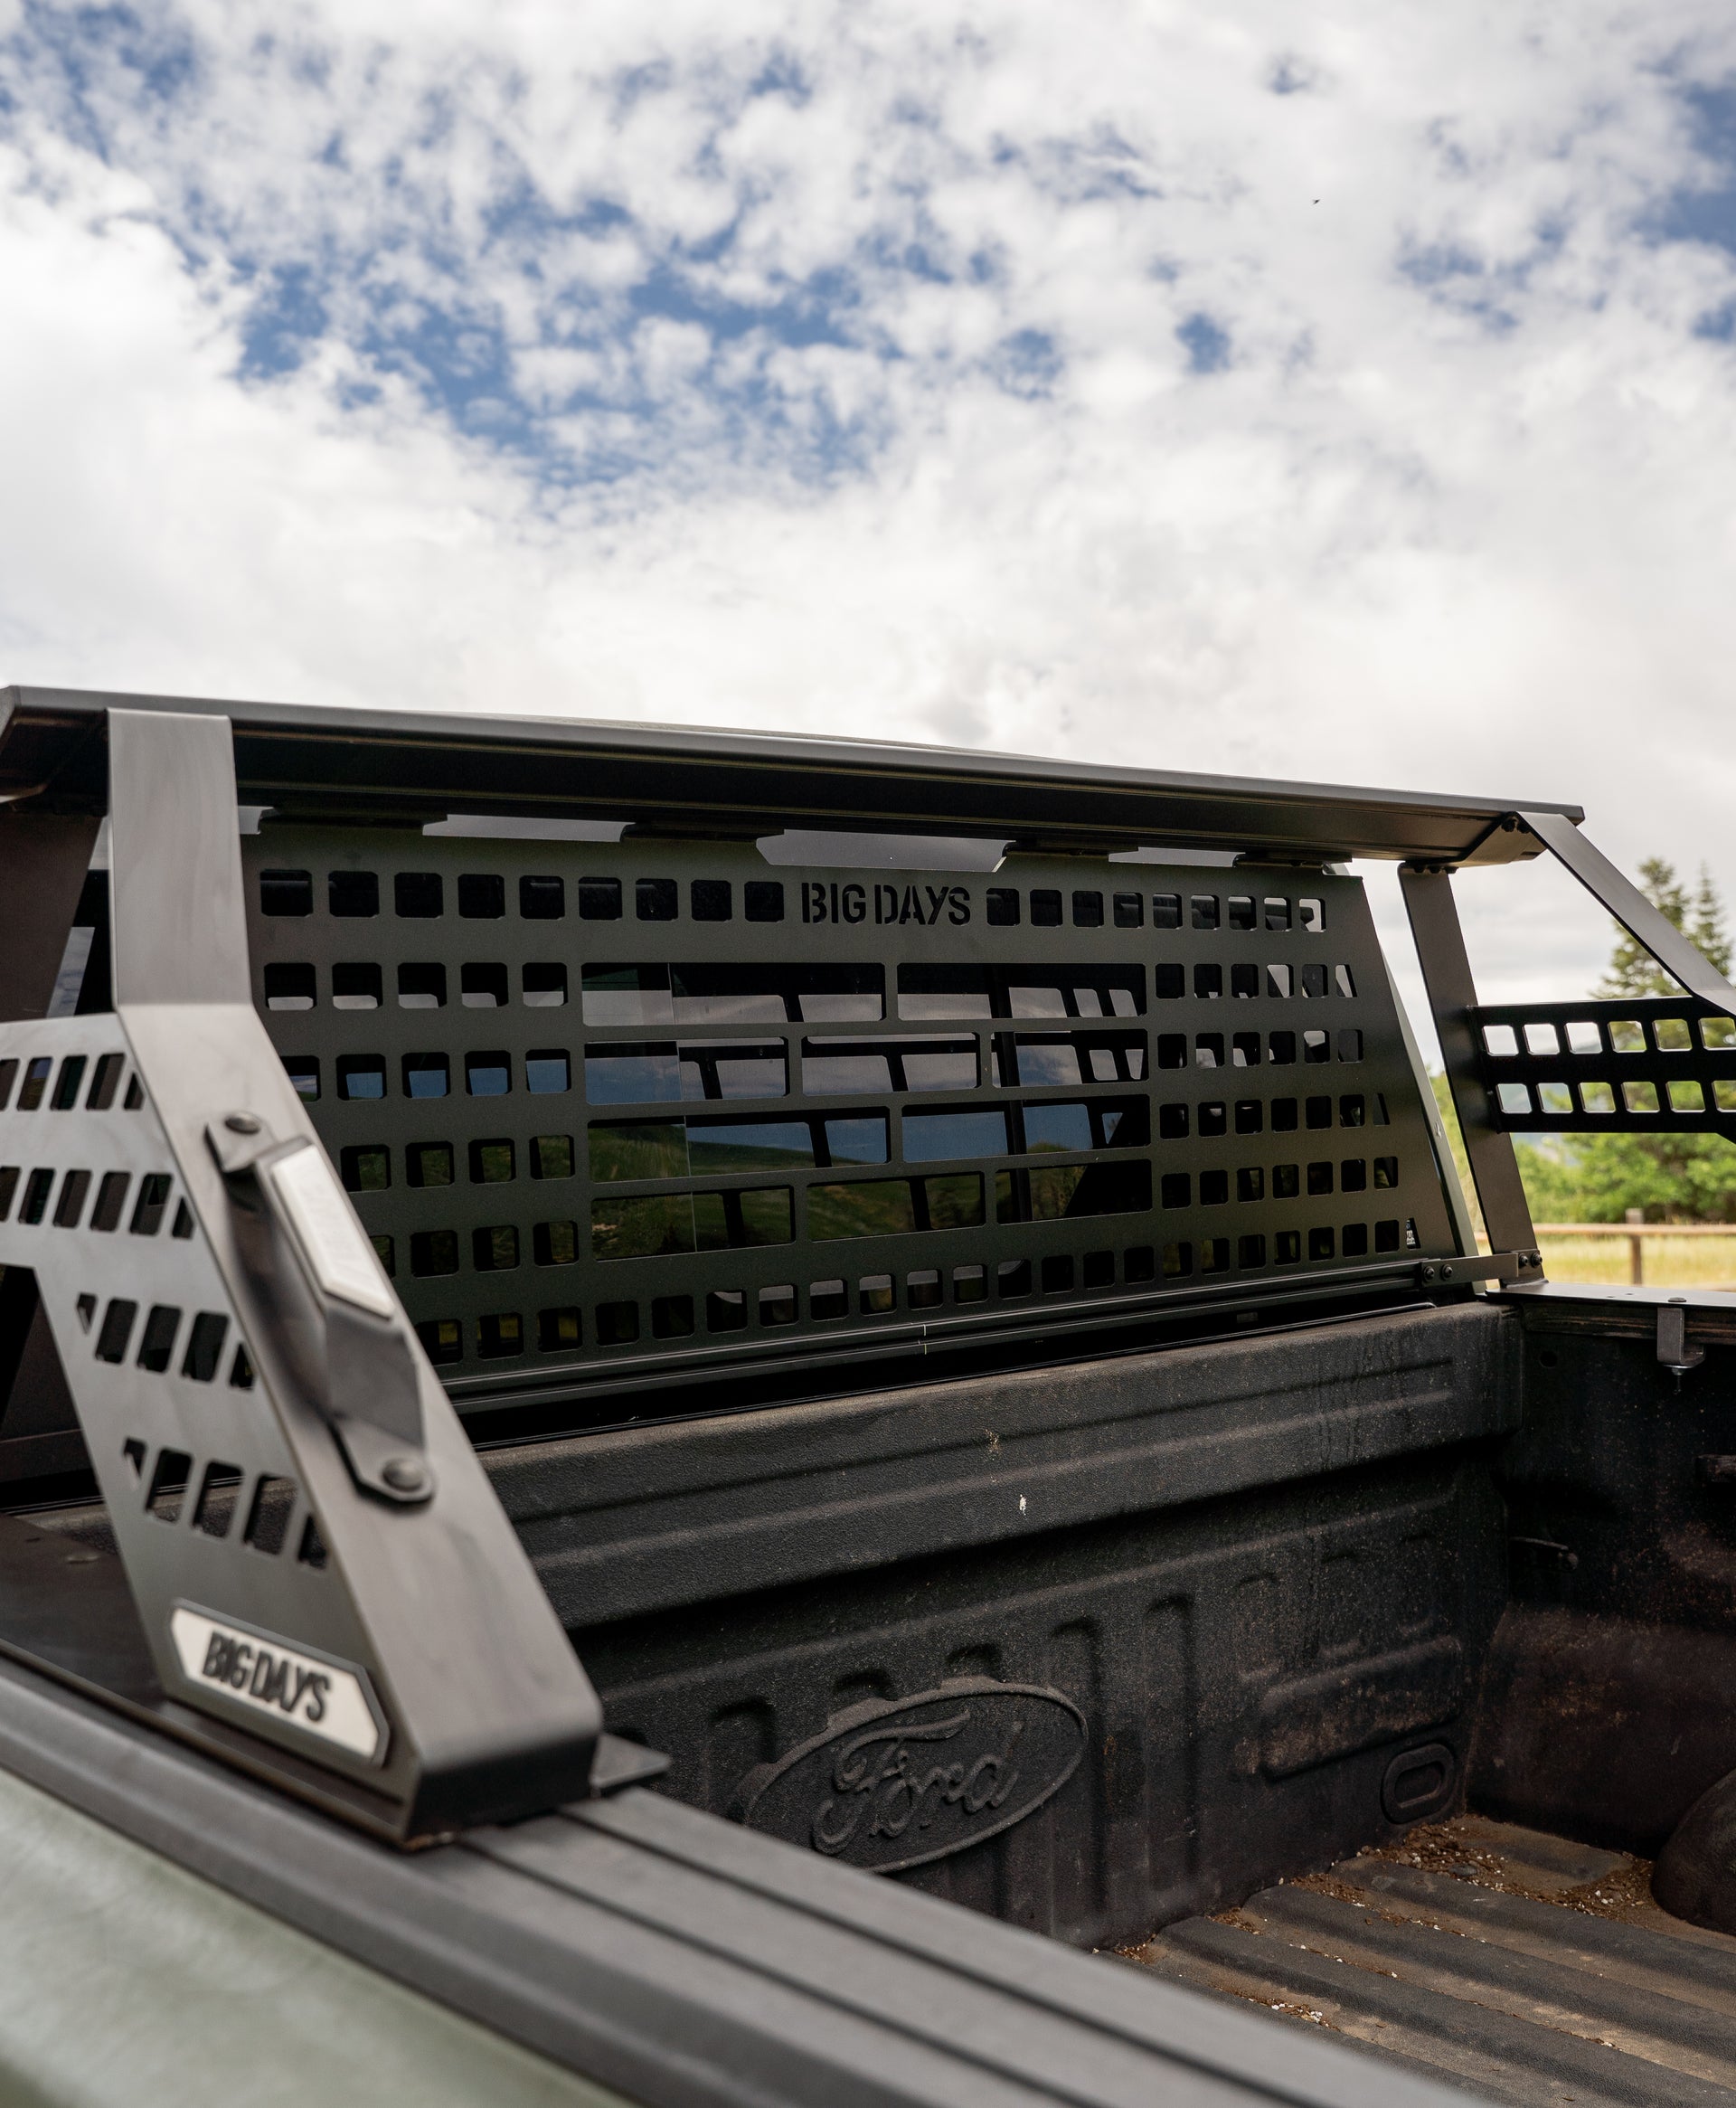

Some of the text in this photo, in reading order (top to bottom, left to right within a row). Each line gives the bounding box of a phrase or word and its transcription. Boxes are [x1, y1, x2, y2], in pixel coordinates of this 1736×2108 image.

[801, 883, 971, 926] BIG DAYS
[202, 1631, 331, 1722] BIG DAYS
[811, 1709, 1024, 1855] Ford
